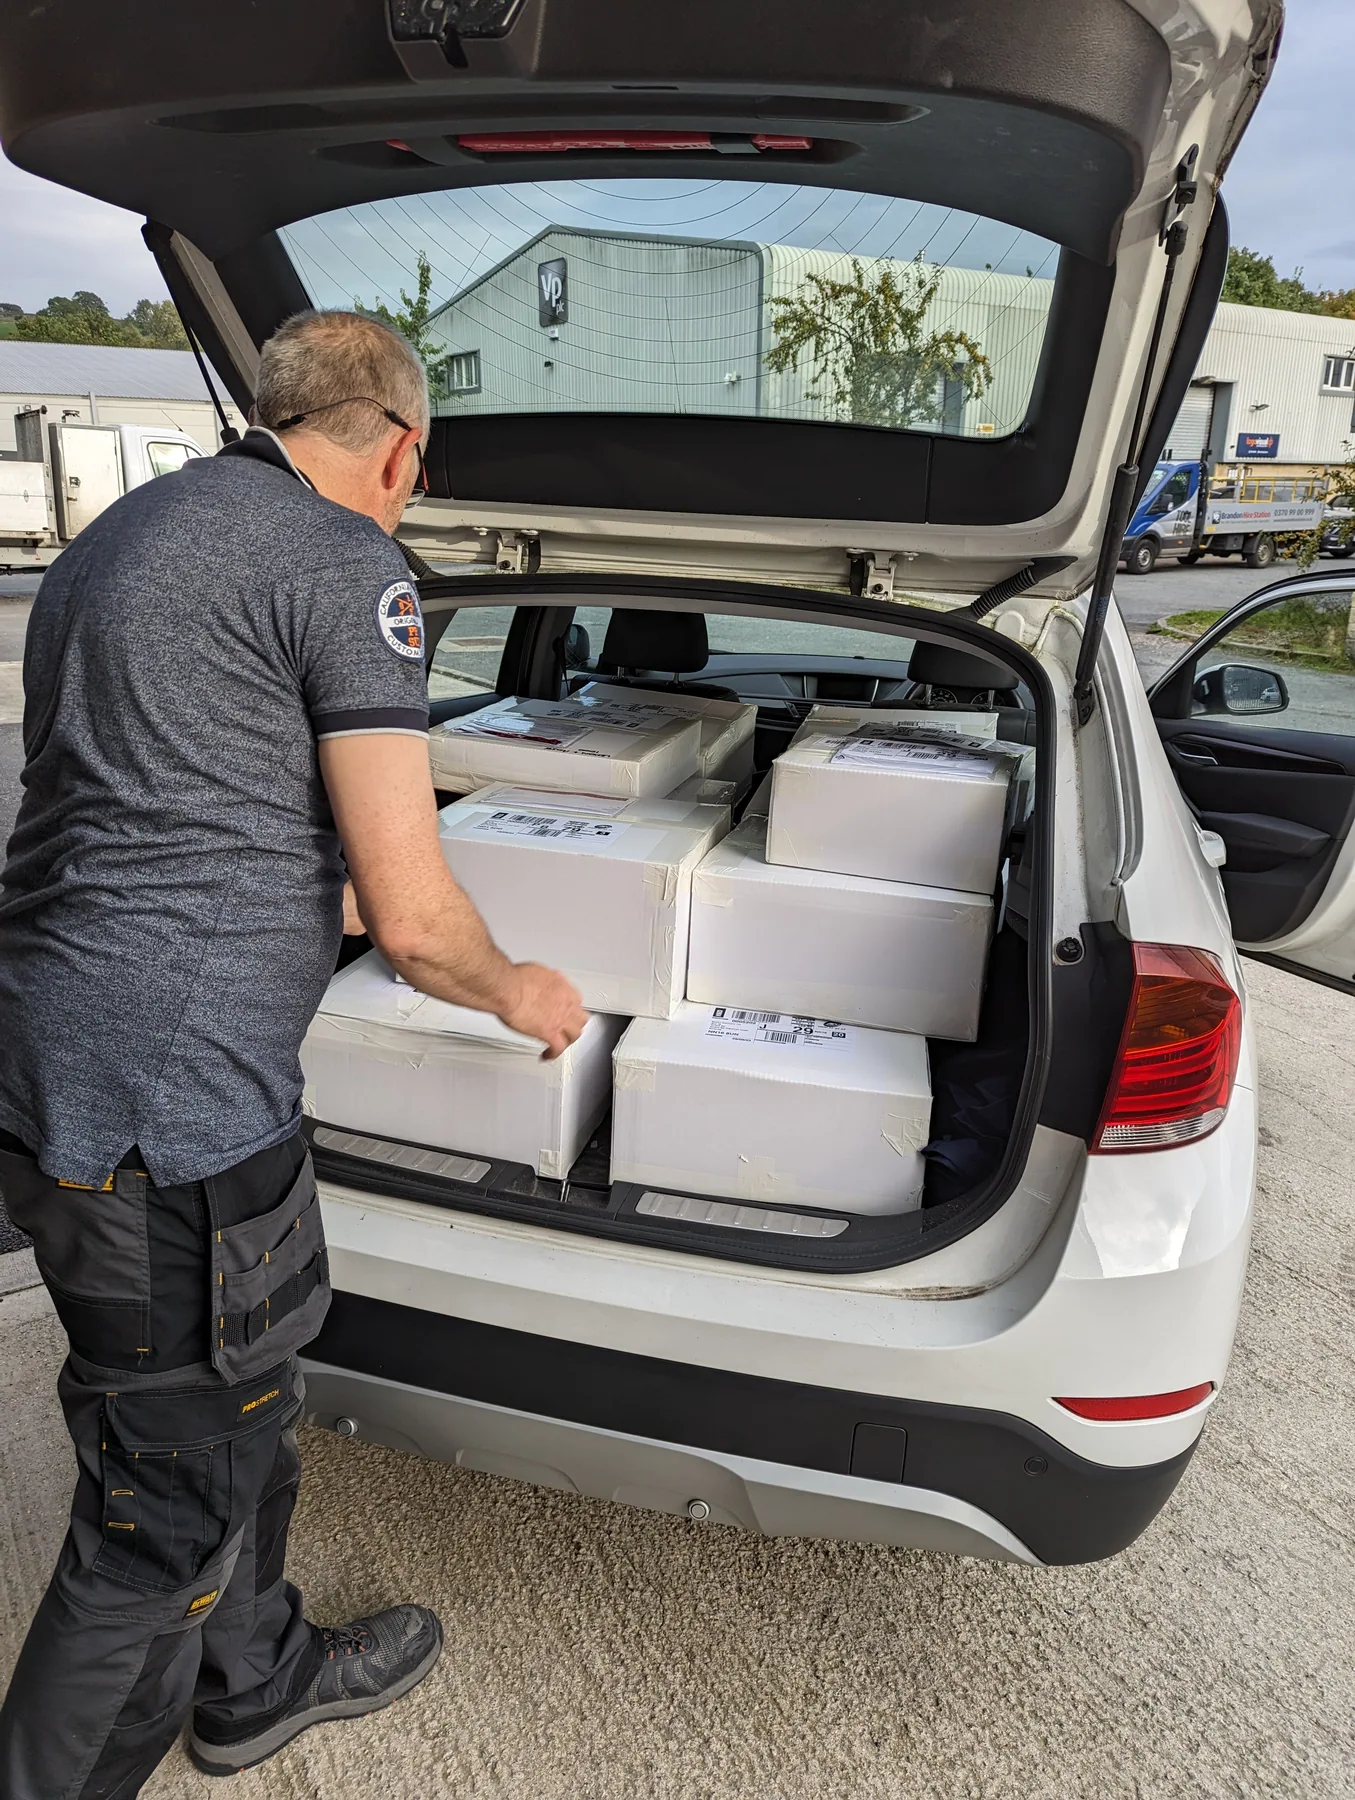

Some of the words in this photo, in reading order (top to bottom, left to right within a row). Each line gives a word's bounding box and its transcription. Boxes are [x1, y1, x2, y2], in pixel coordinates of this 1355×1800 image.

[541, 273, 563, 308] Vp
[1221, 511, 1243, 520] Brandon
[1274, 508, 1288, 516] 0370
[1304, 507, 1316, 516] 999
[793, 1026, 814, 1035] 29
[242, 1389, 279, 1414] PROSTRETCH
